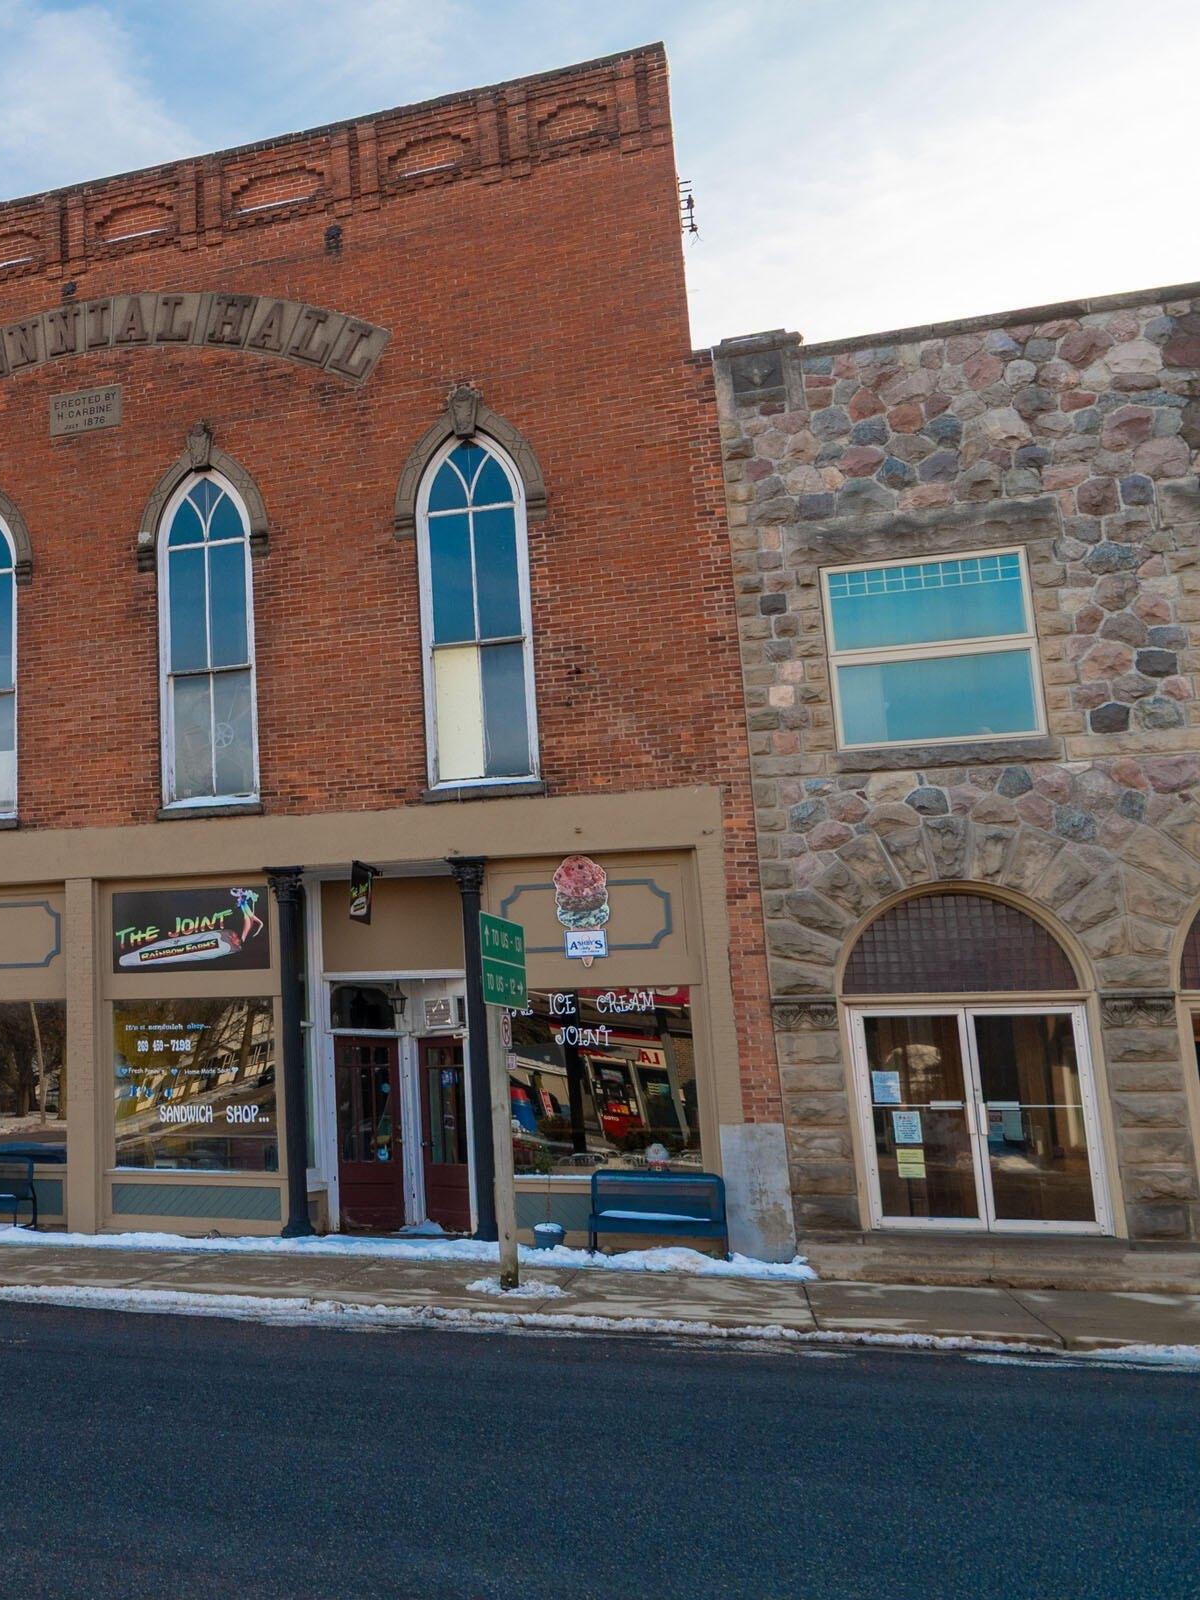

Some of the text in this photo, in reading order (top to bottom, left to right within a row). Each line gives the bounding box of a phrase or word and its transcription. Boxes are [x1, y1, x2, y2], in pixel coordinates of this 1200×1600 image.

[207, 294, 373, 379] HALL
[54, 392, 116, 410] ERECTED BY
[83, 416, 106, 427] 1876
[115, 909, 233, 949] THE JOINT
[491, 928, 500, 946] TO
[500, 930, 509, 949] US
[141, 946, 185, 960] RAINBOW
[486, 972, 494, 991] TO
[496, 975, 505, 993] US
[509, 978, 516, 995] 12
[547, 992, 577, 1015] ICE
[596, 991, 656, 1013] CREAM
[554, 1024, 614, 1046] JOINT
[159, 1104, 213, 1124] SANDWICH
